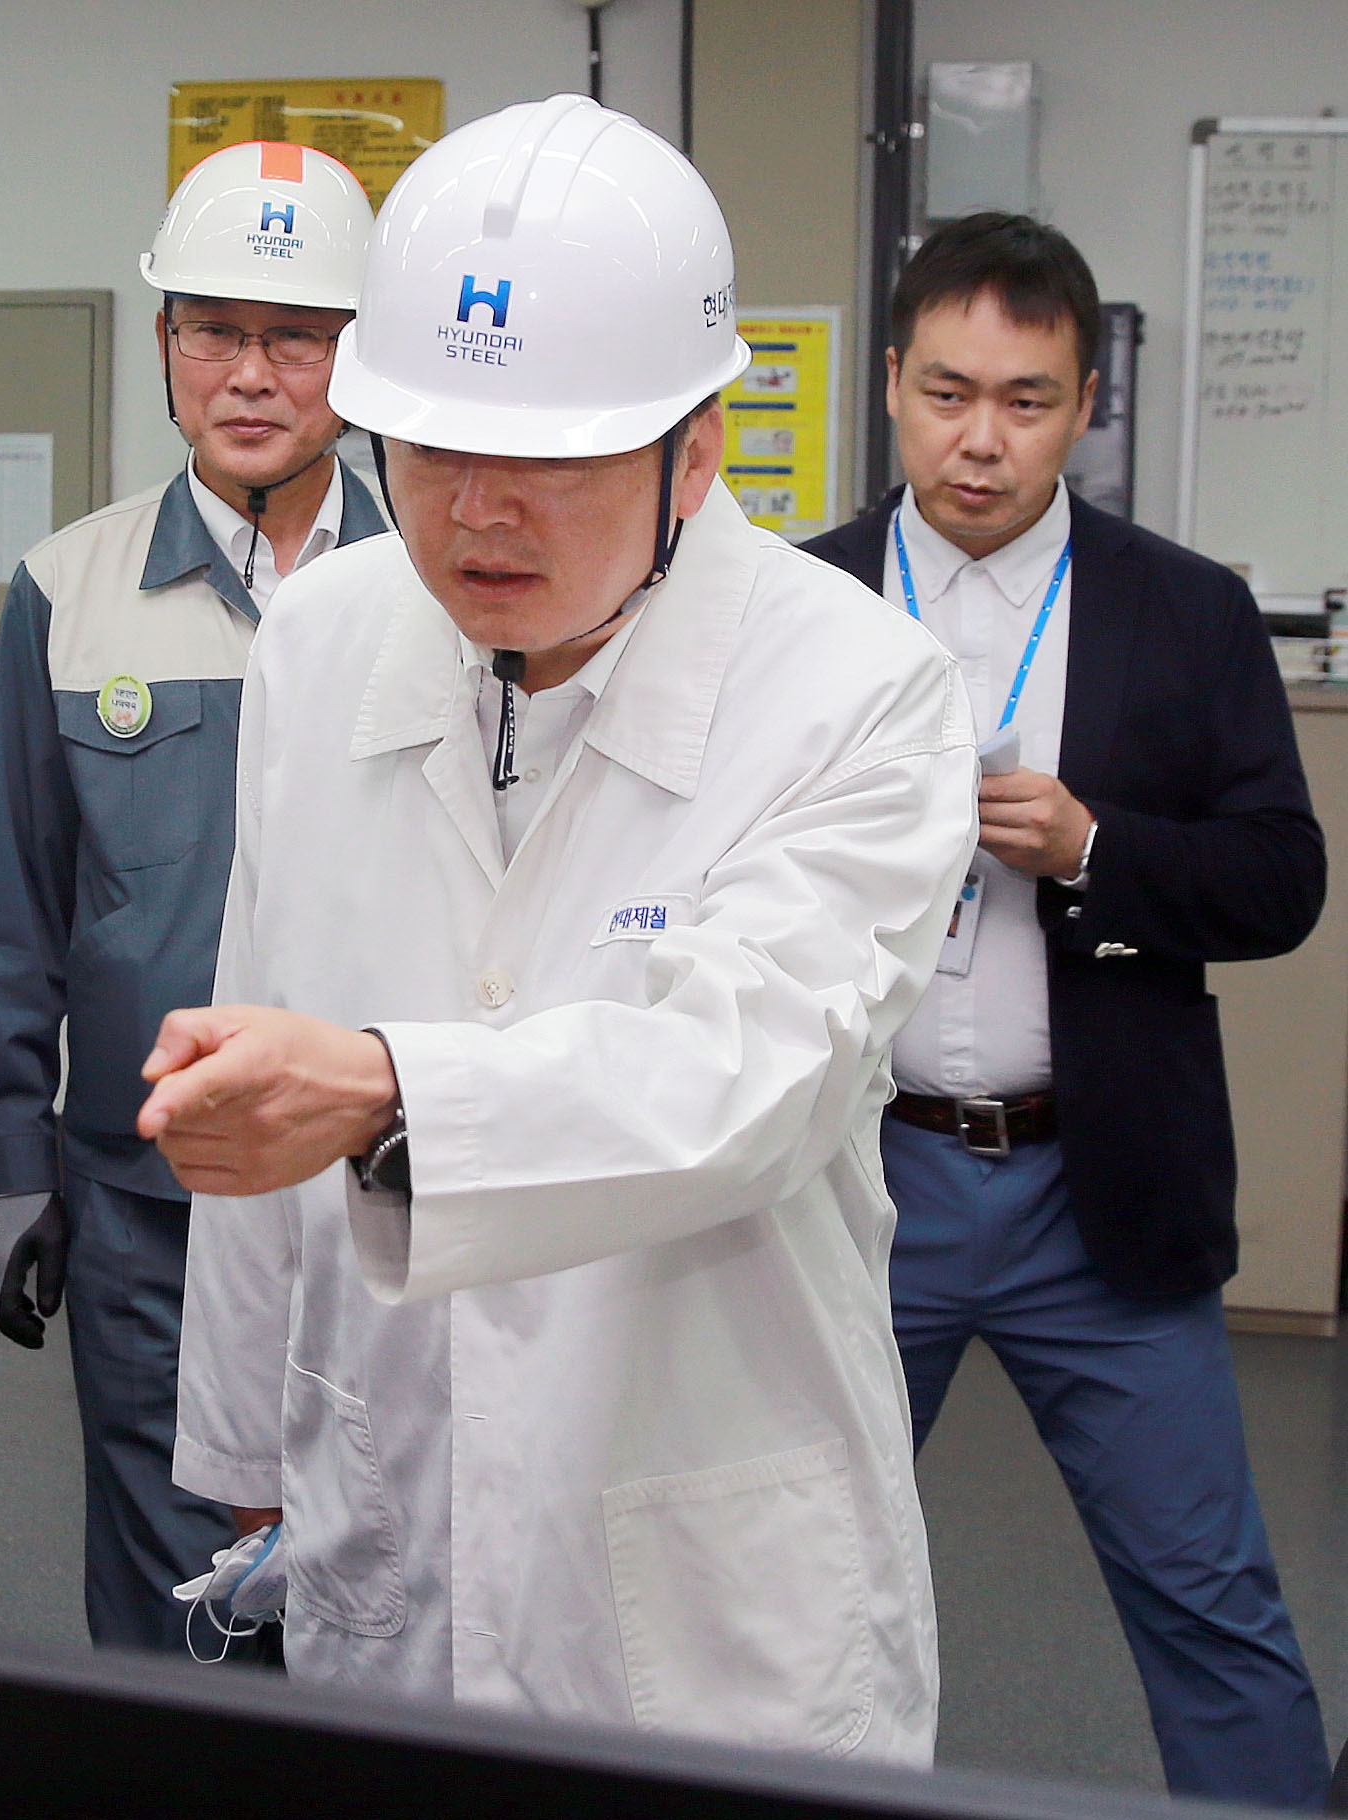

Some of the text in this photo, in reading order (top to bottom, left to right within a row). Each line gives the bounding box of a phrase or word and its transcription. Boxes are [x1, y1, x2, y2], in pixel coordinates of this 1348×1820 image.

[246, 233, 304, 250] HYUNDAI
[253, 245, 295, 260] STEEL
[437, 325, 524, 353] HYUNDAI
[445, 344, 508, 367] STEEL
